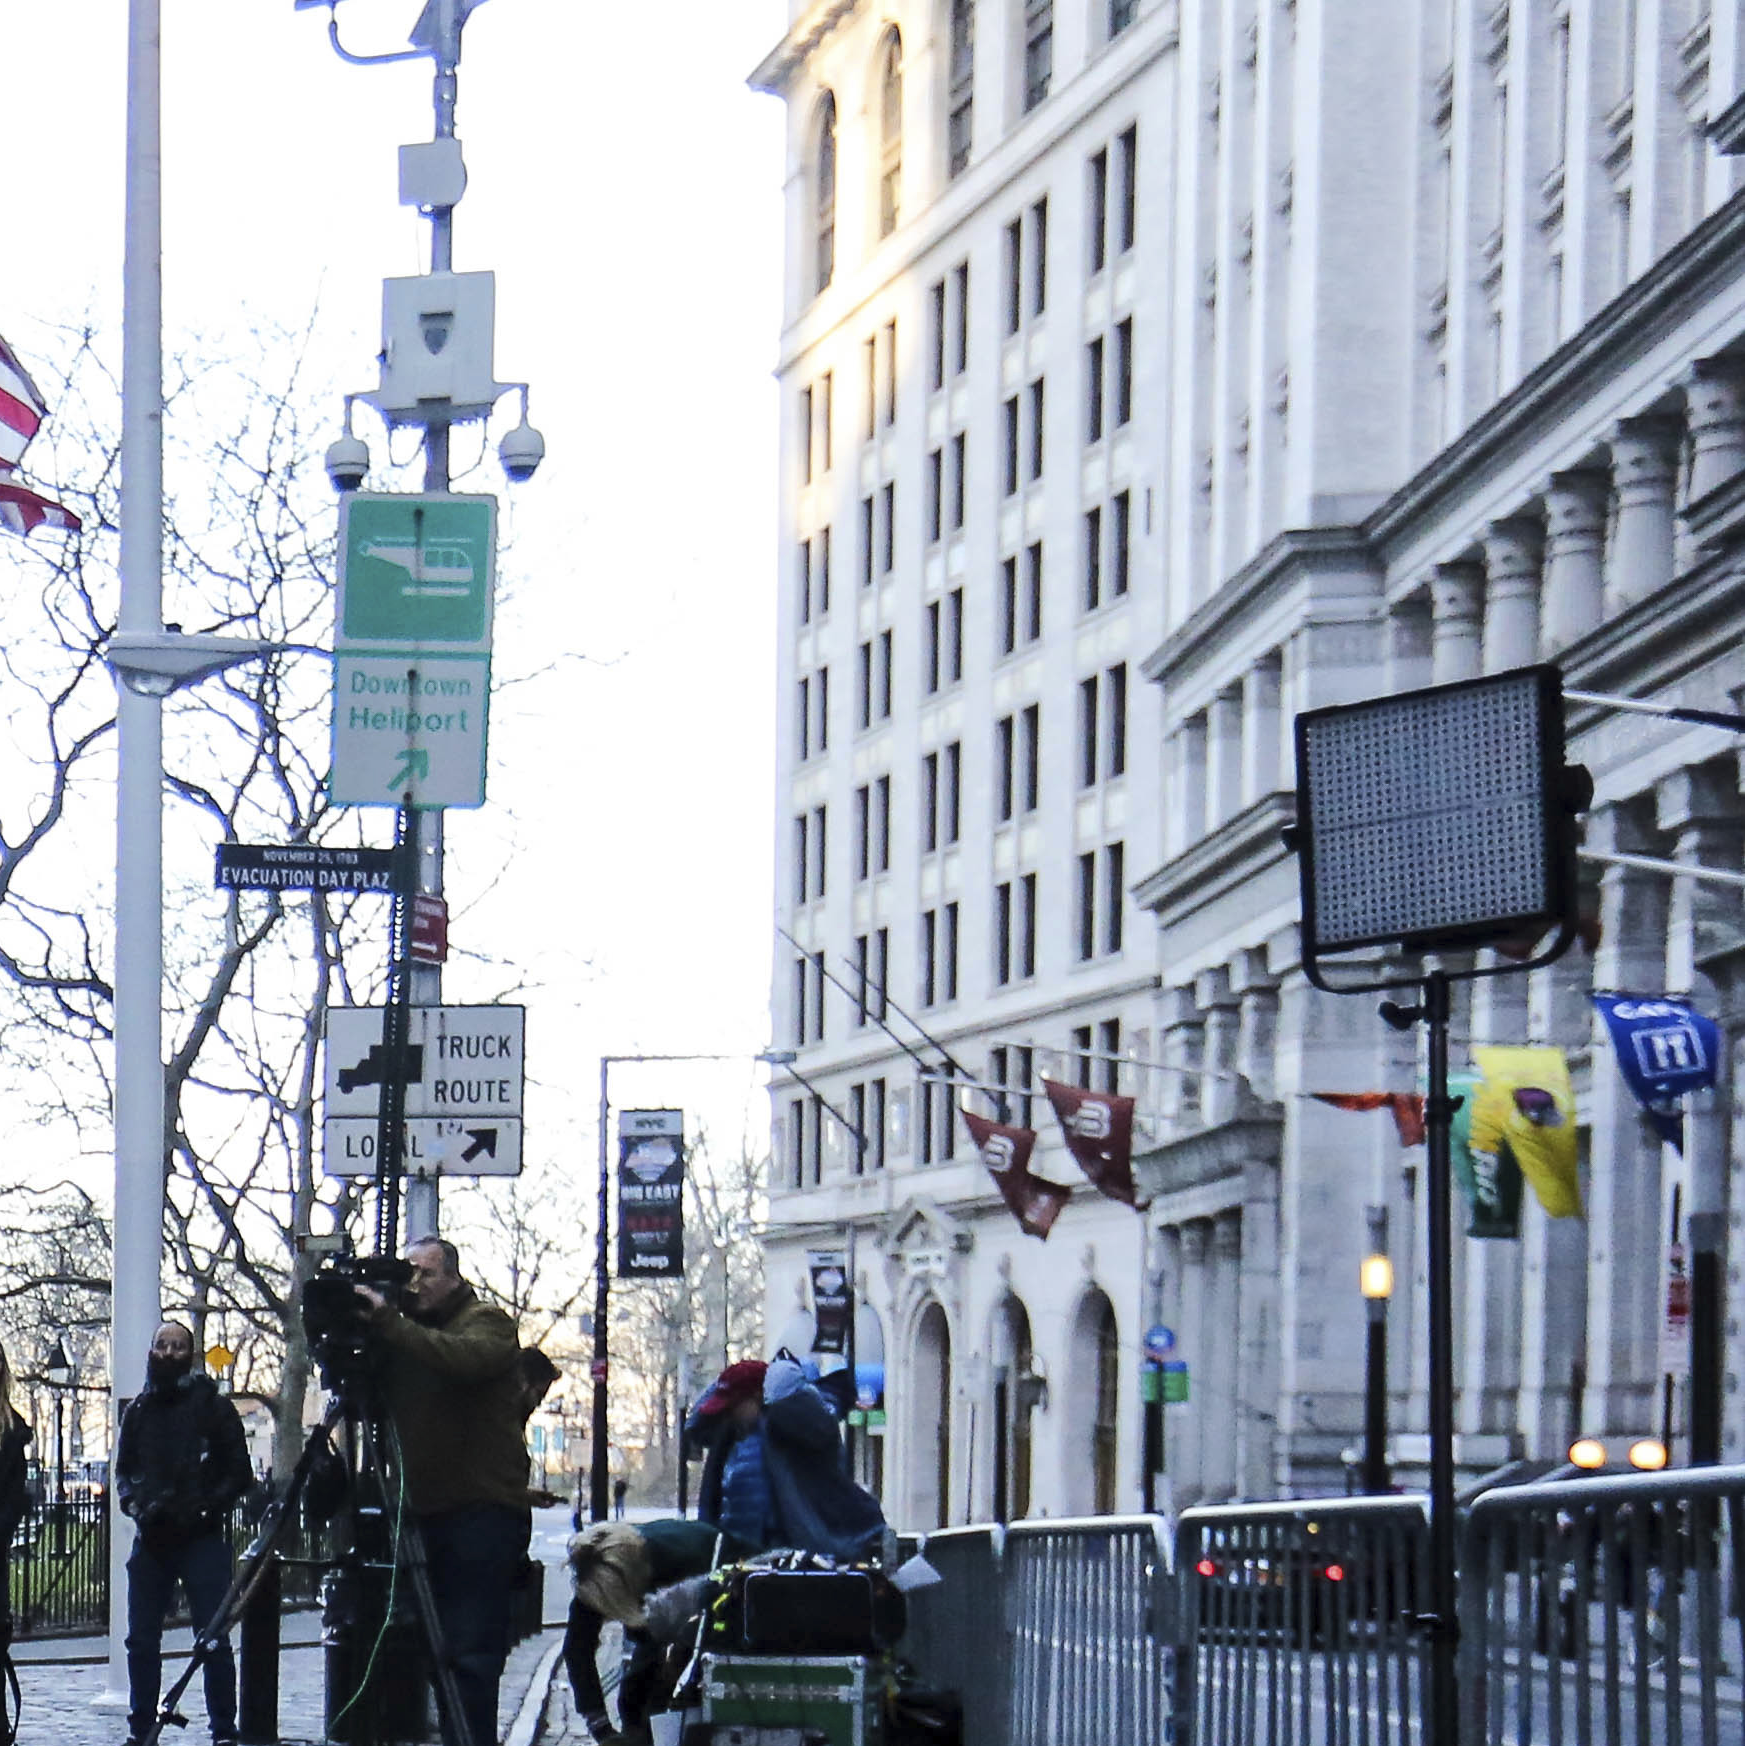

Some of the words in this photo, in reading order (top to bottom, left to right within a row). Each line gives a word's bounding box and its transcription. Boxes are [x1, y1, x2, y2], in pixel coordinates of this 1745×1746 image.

[349, 706, 469, 734] Heliport
[263, 851, 315, 863] NOVEMBER
[221, 866, 315, 886] EVACUATION
[319, 870, 348, 886] DAY
[353, 872, 390, 888] PLAZ
[436, 1034, 512, 1059] TRUCK
[434, 1079, 511, 1104] ROUTE
[346, 1135, 424, 1158] LOL
